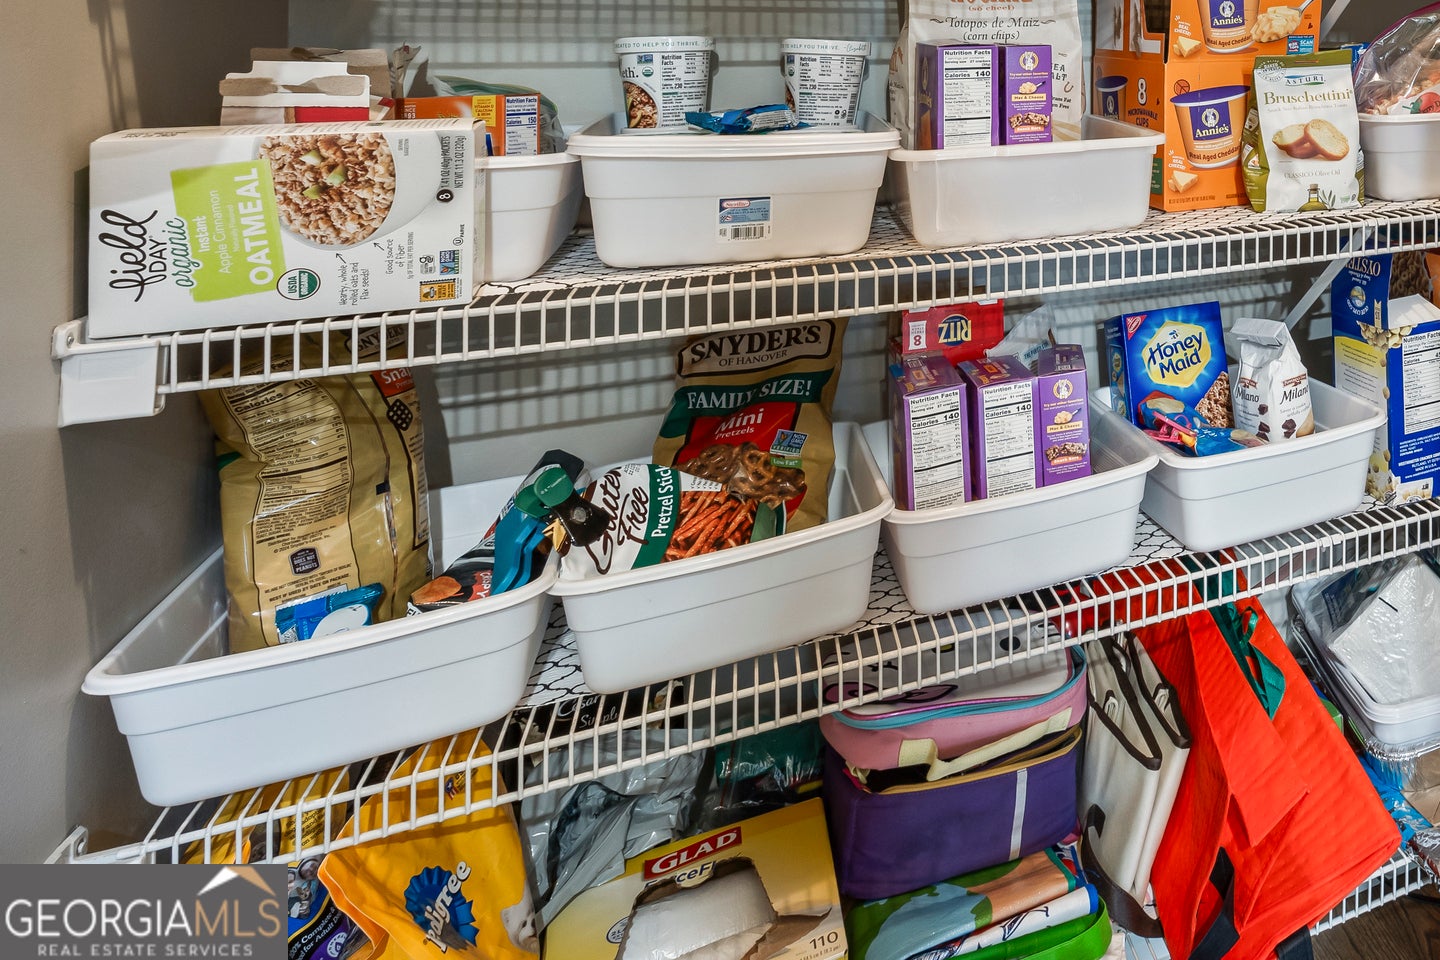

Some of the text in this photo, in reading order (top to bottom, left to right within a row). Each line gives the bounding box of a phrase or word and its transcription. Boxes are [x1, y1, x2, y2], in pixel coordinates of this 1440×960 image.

[945, 16, 1040, 31] Totopos Maiz
[1212, 14, 1243, 26] Annie's
[963, 30, 1020, 43] (corn chips)
[1218, 38, 1230, 47] Aged
[1285, 75, 1325, 86] ASTURI
[1137, 78, 1147, 106] 8
[1264, 88, 1349, 106] Bruschettini
[1127, 107, 1159, 121] MICROWAVABLE
[1136, 118, 1149, 127] CUPS
[1195, 124, 1229, 138] Annie's
[1284, 171, 1314, 179] CLASSICO
[192, 215, 210, 253] Instant
[233, 167, 275, 286] OATMEAL
[162, 217, 201, 288] organic
[287, 275, 297, 294] USDA
[938, 320, 972, 344] RITZ
[690, 325, 822, 365] SNYDER'S
[1147, 331, 1203, 366] Honey
[719, 349, 788, 367] OF HANOVER
[1159, 348, 1202, 379] Maid
[1403, 357, 1421, 365] Calories
[687, 379, 812, 410] FAMILY SIZE!
[984, 382, 1031, 395] Nutrition Facts
[235, 391, 284, 414] Calories
[1016, 404, 1032, 412] 140
[716, 408, 764, 435] Mini
[943, 412, 960, 421] 140
[715, 427, 755, 440] Pretzels
[618, 486, 651, 547] Free
[651, 495, 672, 538] Pretzel
[651, 832, 738, 874] GLAD
[810, 931, 839, 950] 110
